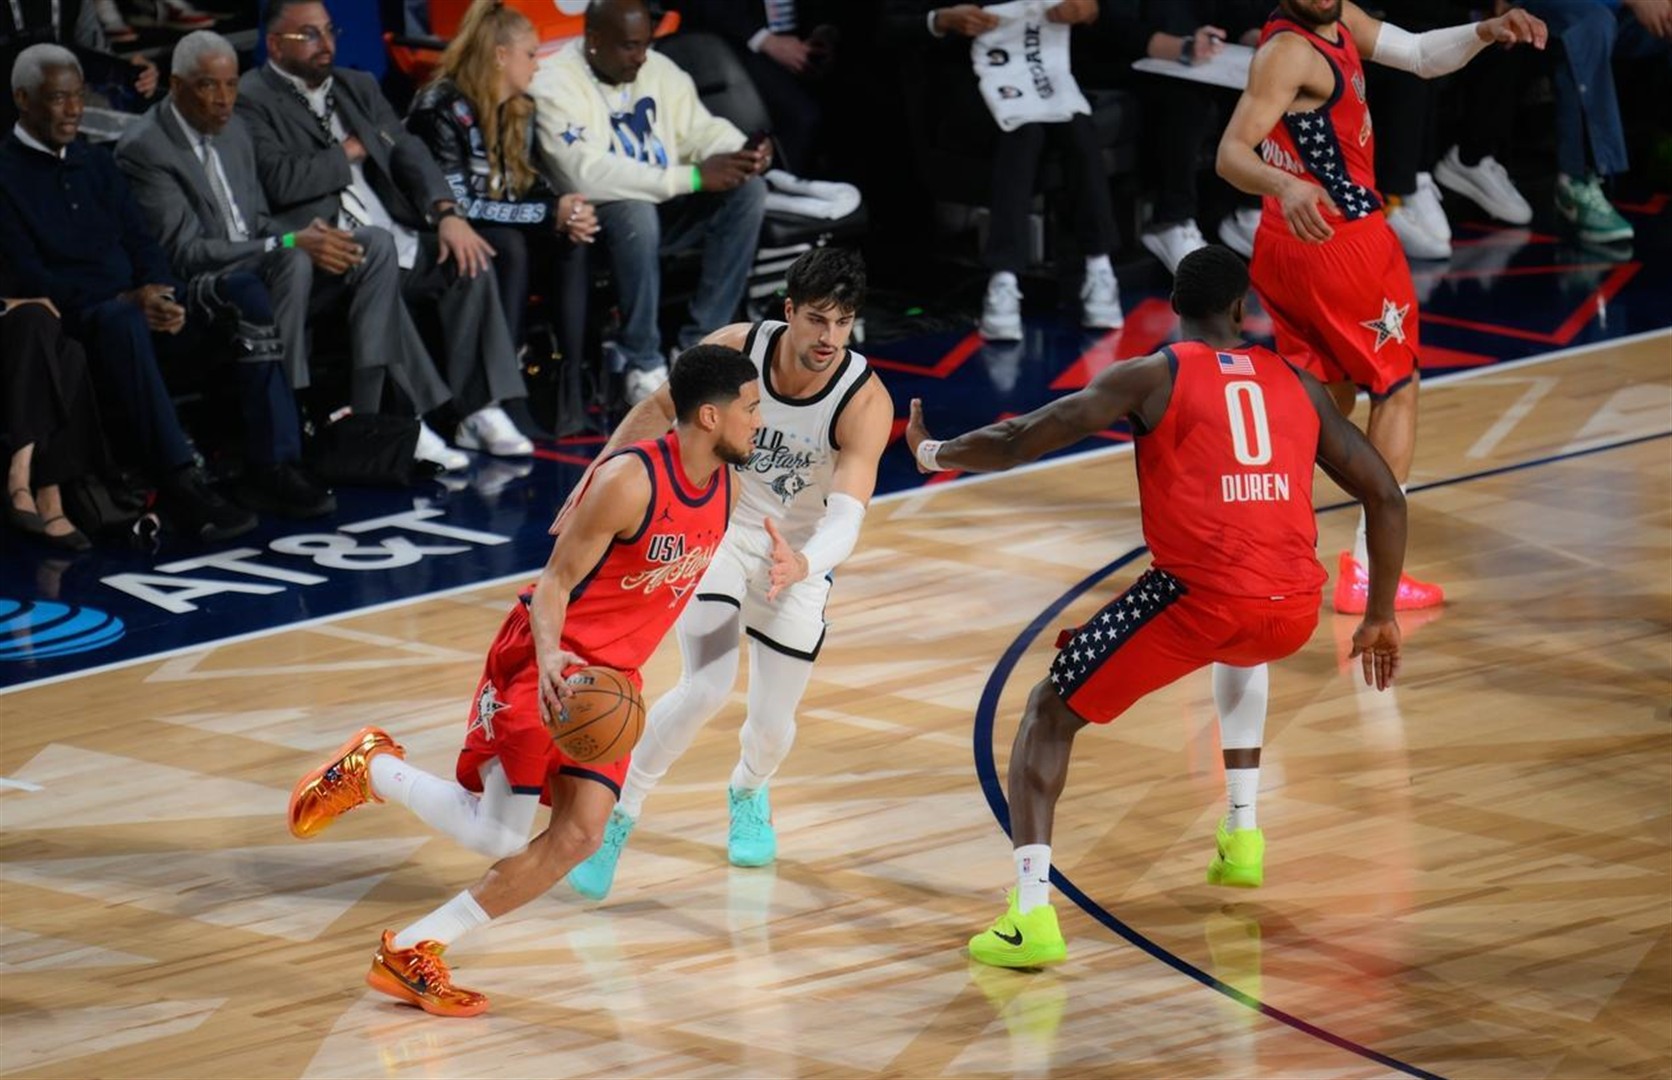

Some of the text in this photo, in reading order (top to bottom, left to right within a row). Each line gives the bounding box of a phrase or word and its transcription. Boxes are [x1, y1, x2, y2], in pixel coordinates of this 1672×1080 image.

[1224, 380, 1272, 466] 0
[1221, 473, 1290, 503] DUREN
[100, 508, 512, 614] AT&T
[646, 533, 686, 564] USA
